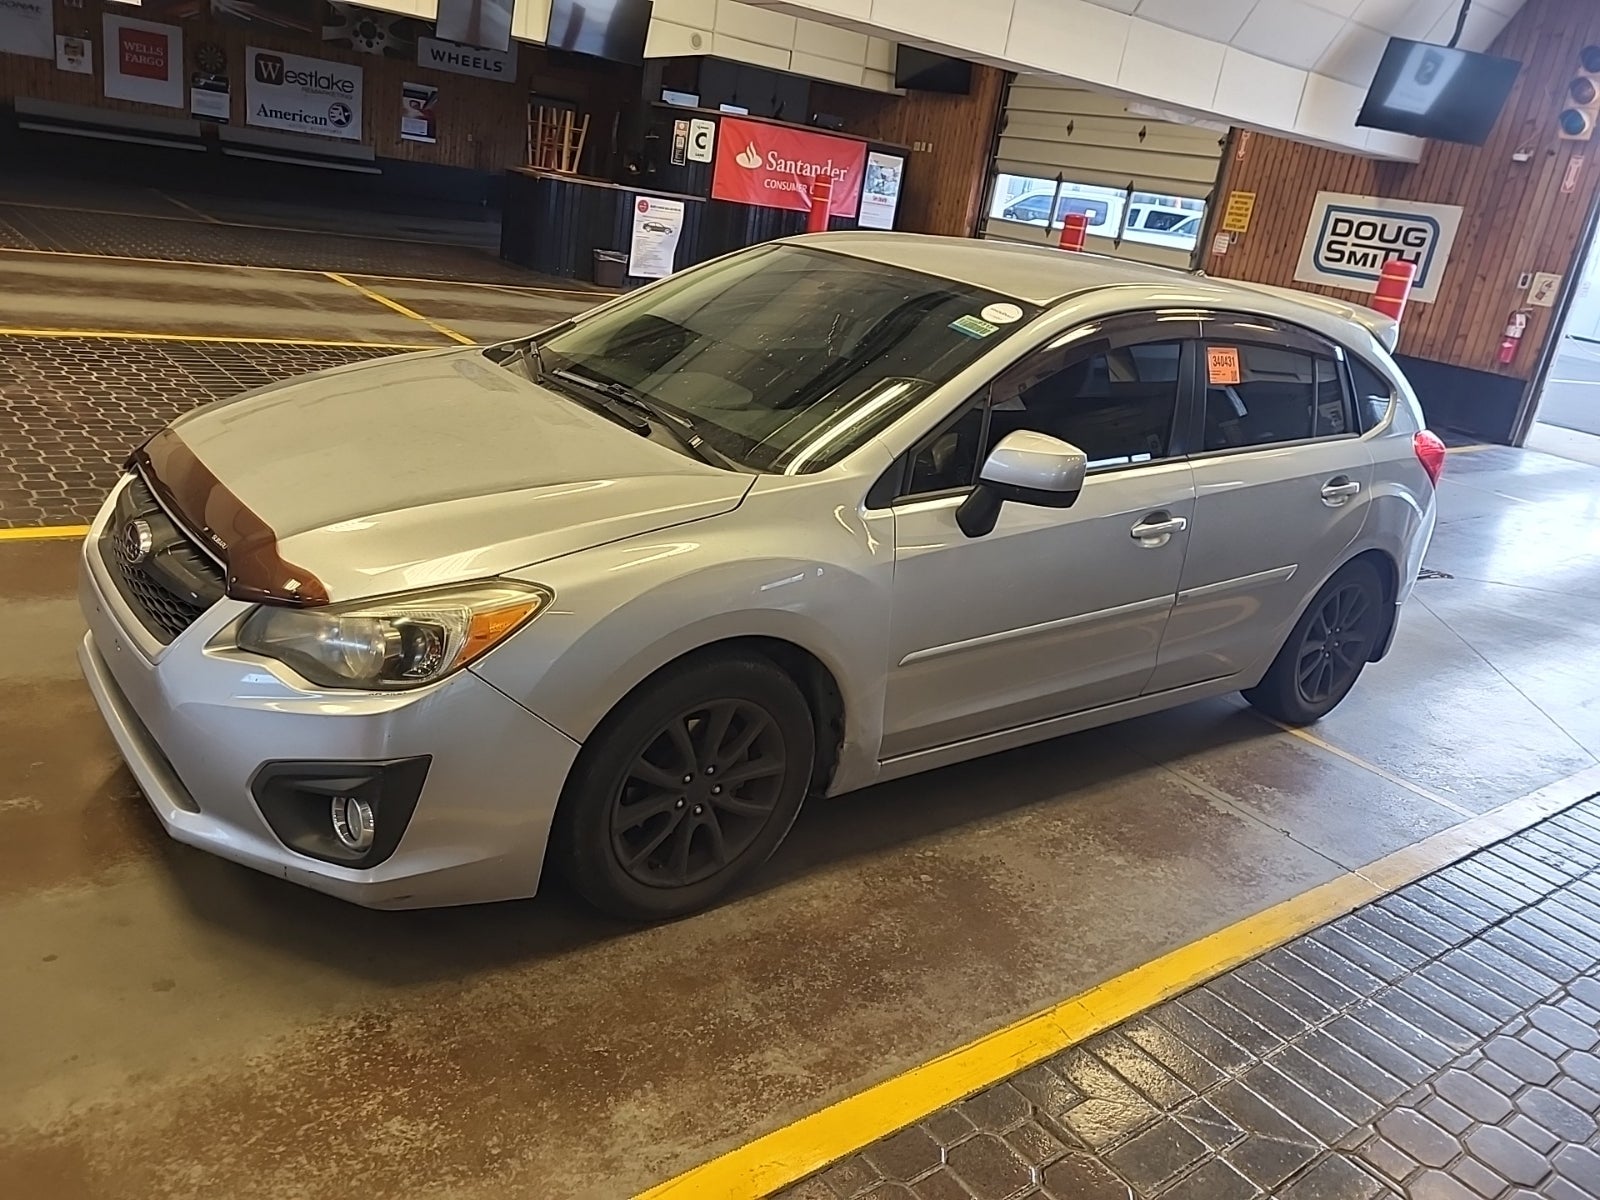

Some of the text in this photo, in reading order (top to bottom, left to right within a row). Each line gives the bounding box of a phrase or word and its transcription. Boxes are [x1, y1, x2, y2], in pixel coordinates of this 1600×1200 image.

[123, 40, 164, 57] WELLS
[125, 52, 164, 68] FARGO
[431, 48, 503, 73] WHEELS
[257, 58, 354, 94] Westlake
[256, 103, 328, 126] American
[694, 131, 708, 150] C
[766, 151, 848, 182] Santander
[763, 178, 808, 194] CONSUMER
[1330, 217, 1428, 248] DOUG
[1212, 355, 1235, 368] 340431
